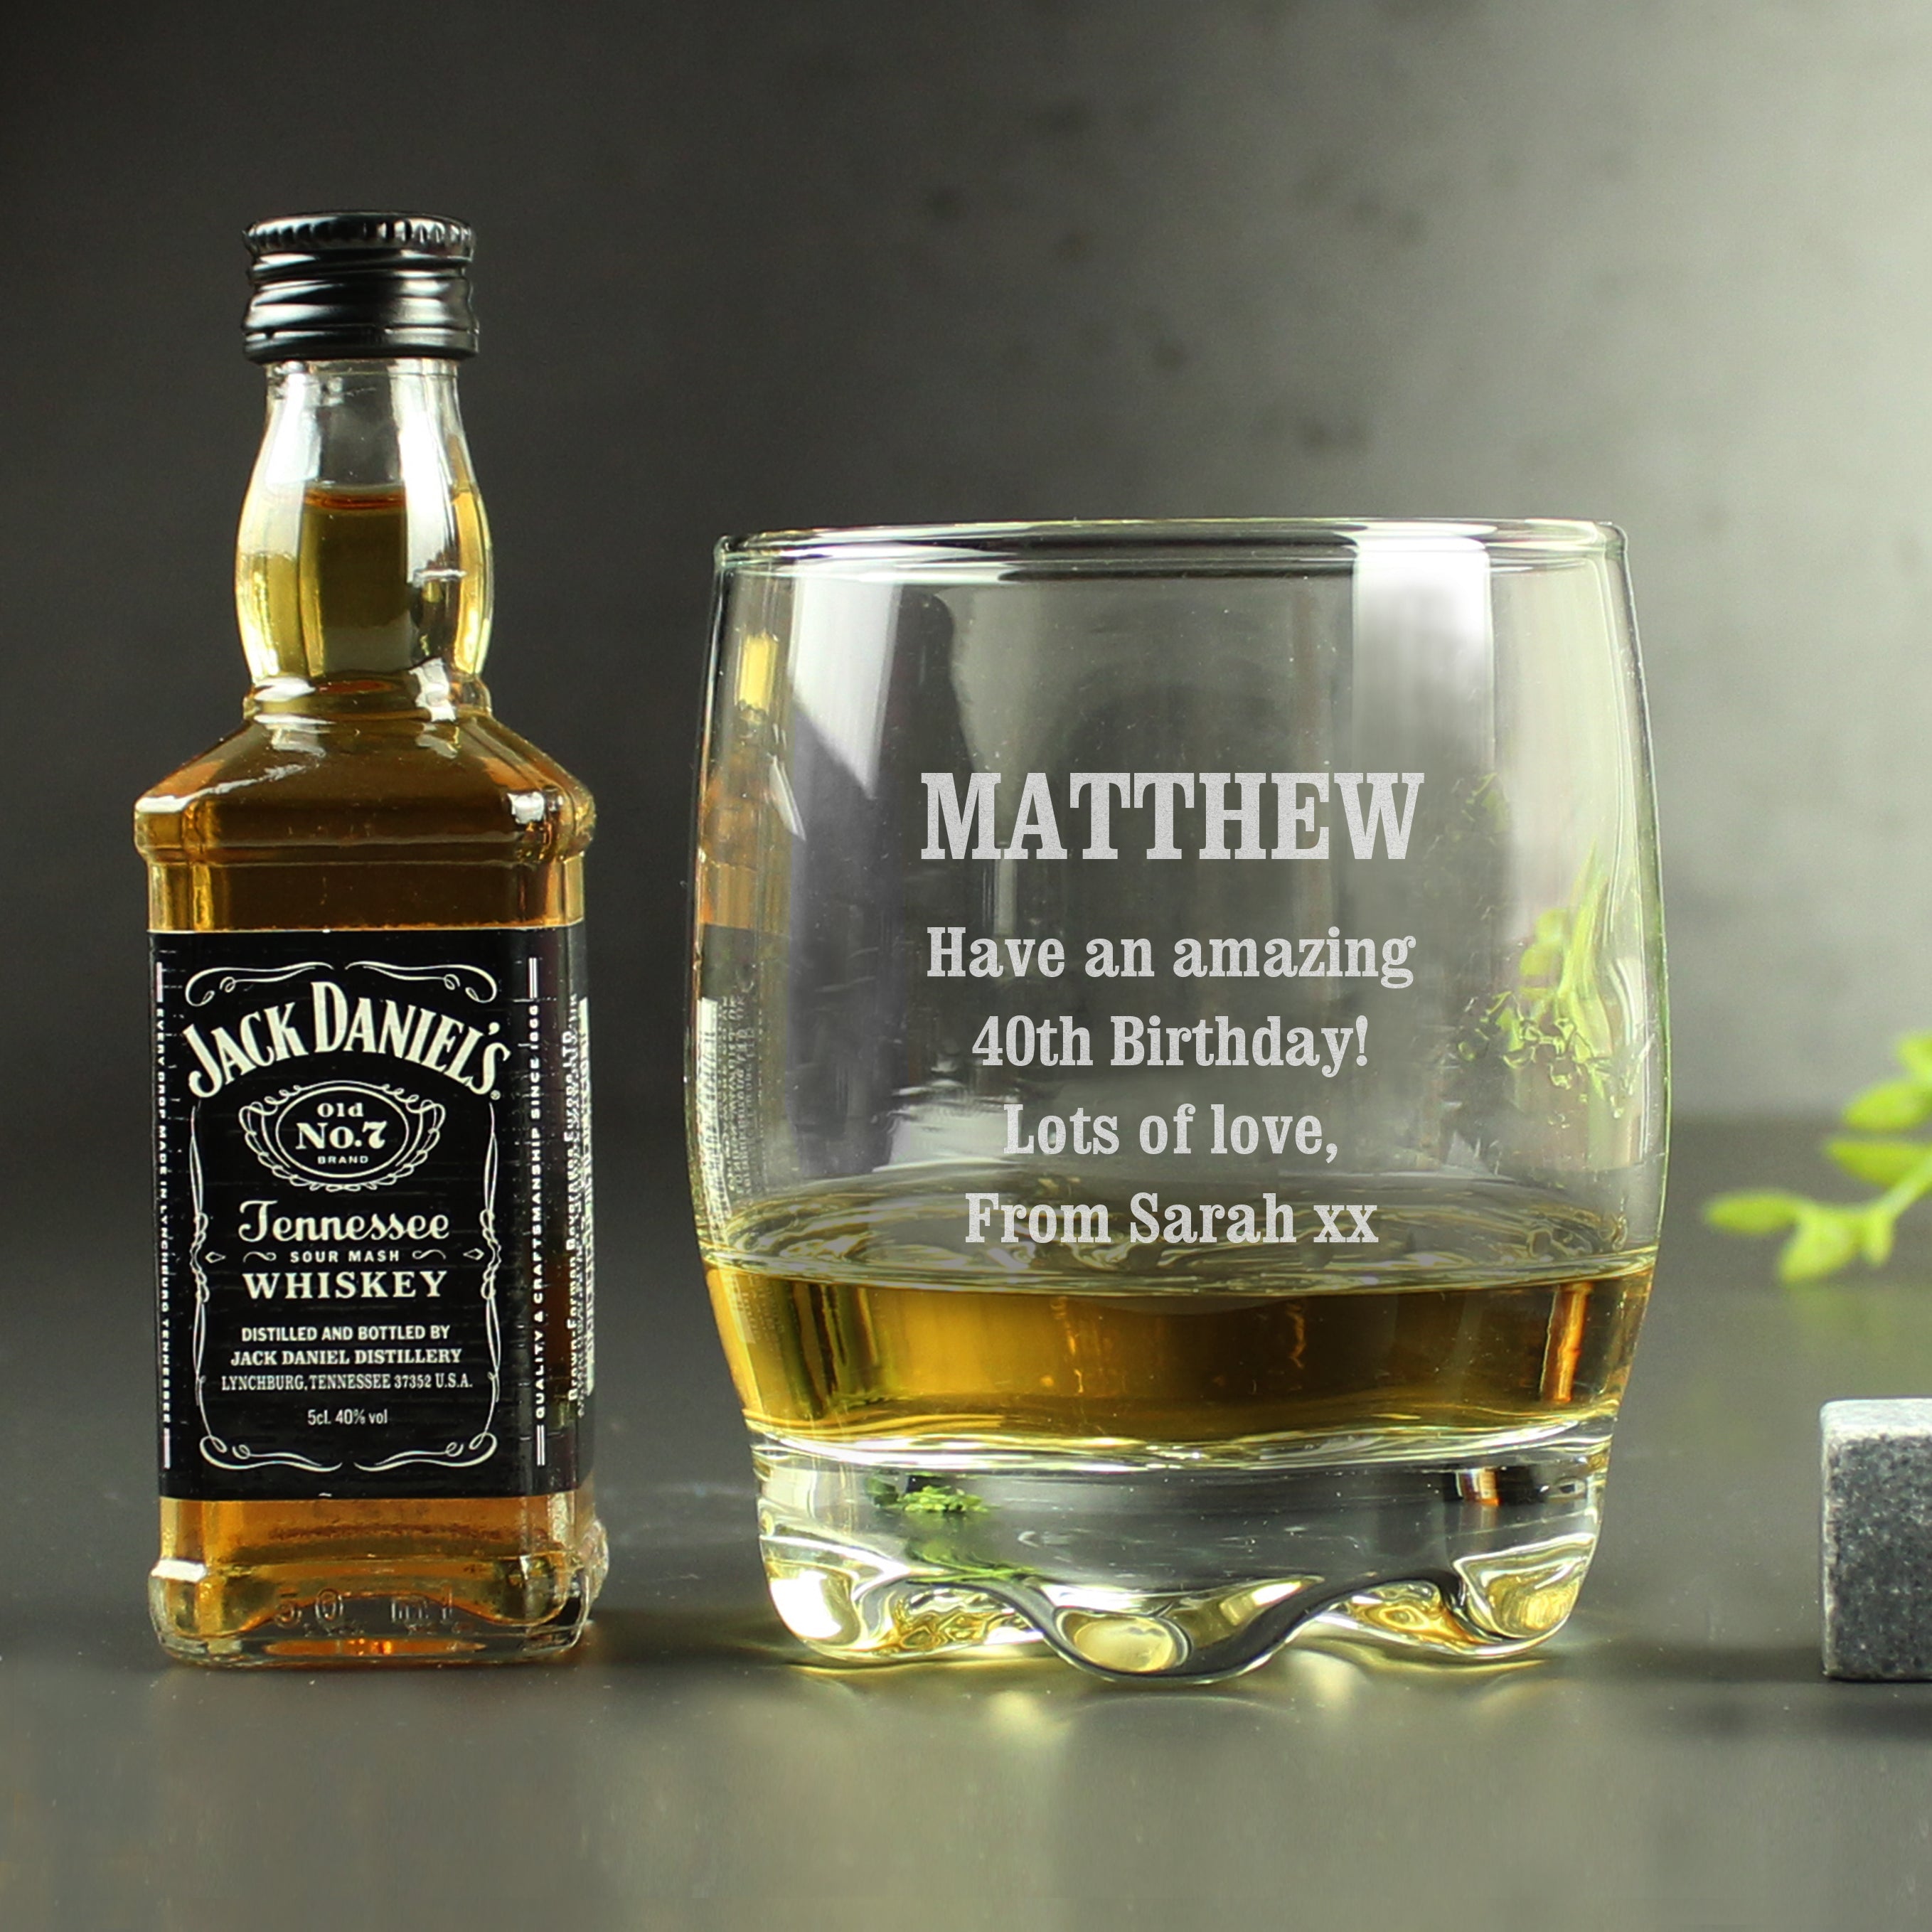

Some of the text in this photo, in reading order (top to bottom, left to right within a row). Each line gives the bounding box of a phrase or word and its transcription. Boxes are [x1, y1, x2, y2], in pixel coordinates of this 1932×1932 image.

[920, 772, 1425, 860] MATTHEW
[927, 926, 1417, 990] Have an amazing
[183, 981, 511, 1099] JACK DANIEL'S
[971, 1015, 1369, 1078] 40th Birthday!
[530, 1057, 540, 1119] SINCE
[316, 1102, 364, 1118] Old
[295, 1120, 388, 1150] No.7
[1003, 1103, 1338, 1164] Lots of love,
[317, 1155, 369, 1165] BRAND
[160, 1180, 167, 1199] IN
[238, 1200, 449, 1243] Tennessee
[531, 1127, 543, 1304] CRAFTSMANSHIP
[965, 1192, 1379, 1244] From Sarah xx
[290, 1249, 400, 1264] SOUR MASH
[242, 1270, 447, 1299] WHISKEY
[534, 1311, 543, 1323] &
[241, 1325, 450, 1342] DISTILLED AND BOTTLED BY
[230, 1348, 462, 1366] JACK DANIEL DISTILLERY
[221, 1372, 473, 1391] LYNCHBURG, TENNESSEE 37352 U.S.A.
[533, 1330, 545, 1419] QUALITY
[335, 1408, 365, 1425] 40%
[368, 1408, 388, 1424] vol
